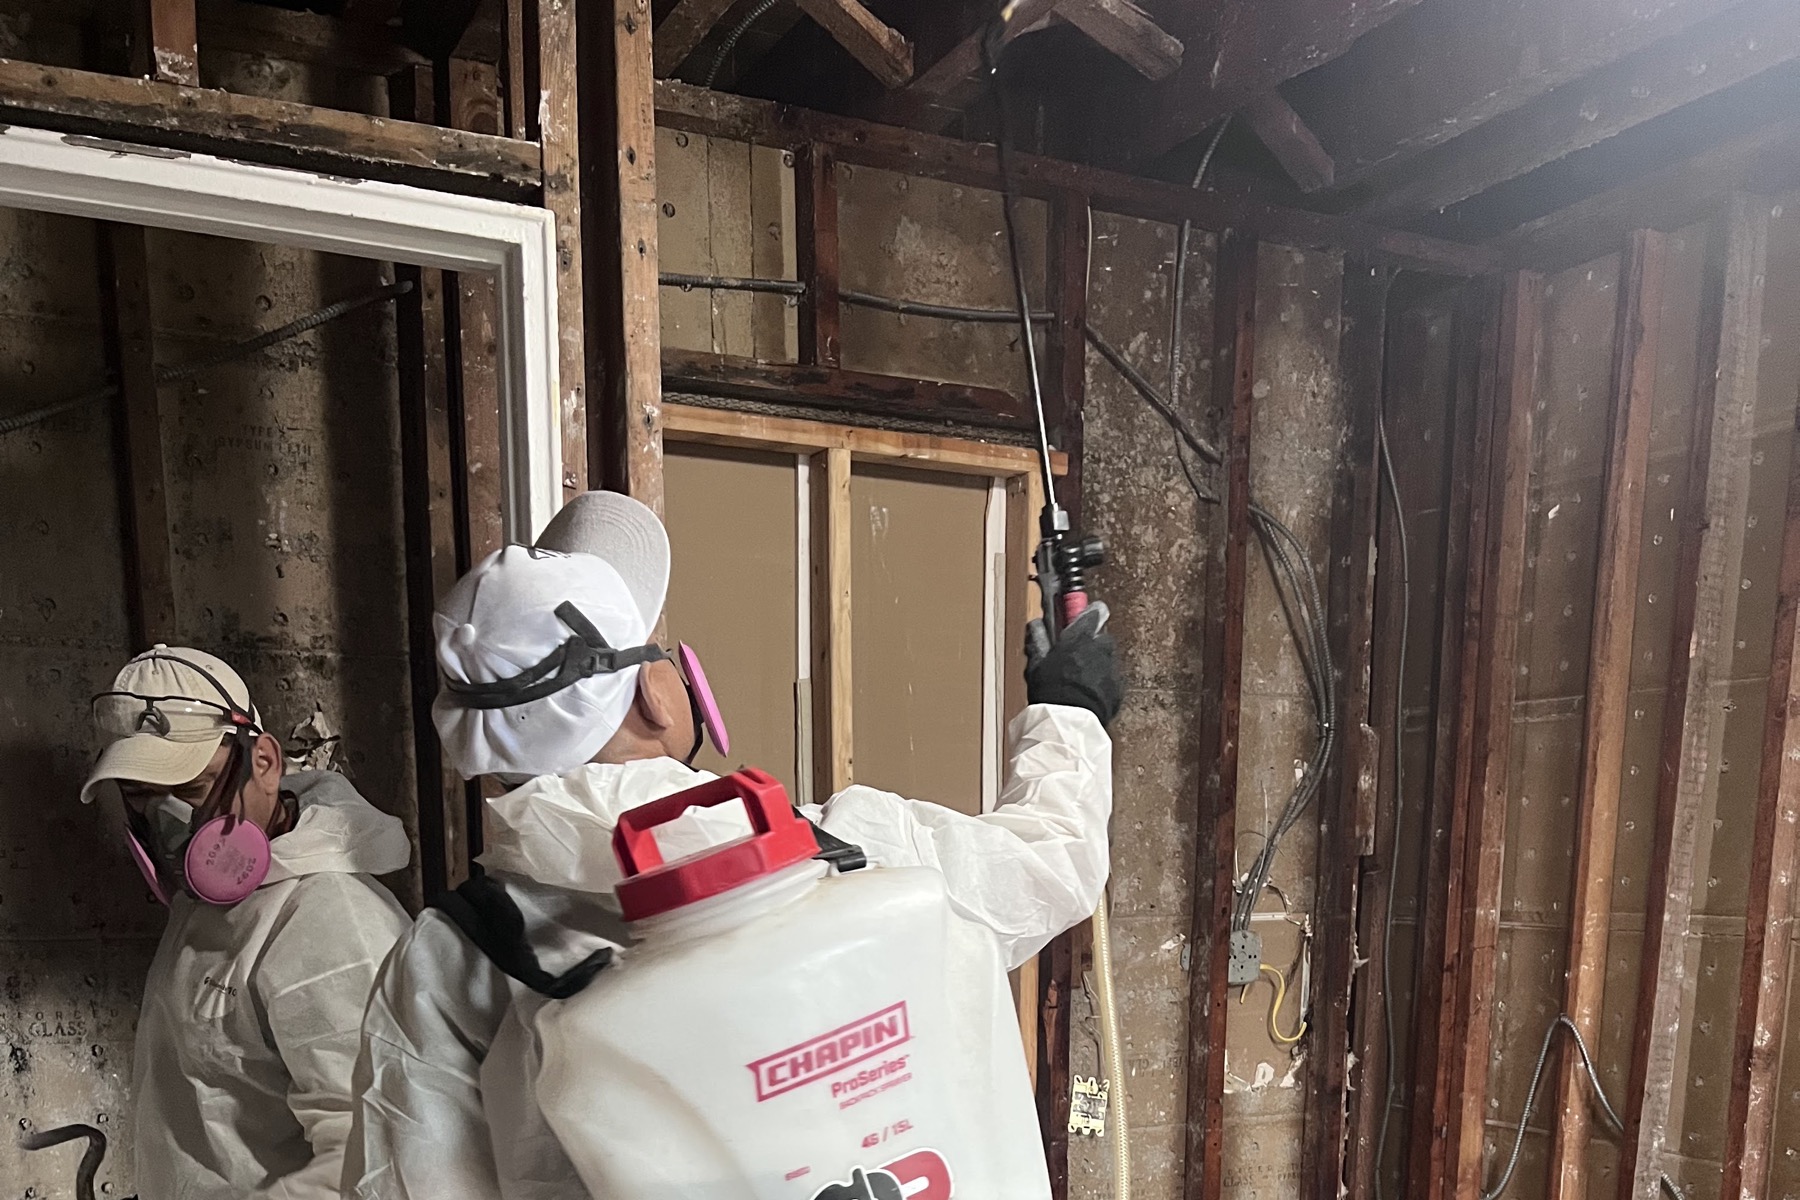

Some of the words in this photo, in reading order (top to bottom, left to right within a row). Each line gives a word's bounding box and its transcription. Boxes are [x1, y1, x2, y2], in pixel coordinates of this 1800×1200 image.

[28, 1020, 88, 1037] GLASS
[768, 1014, 899, 1088] CHAPIN
[831, 1055, 908, 1098] ProSeries
